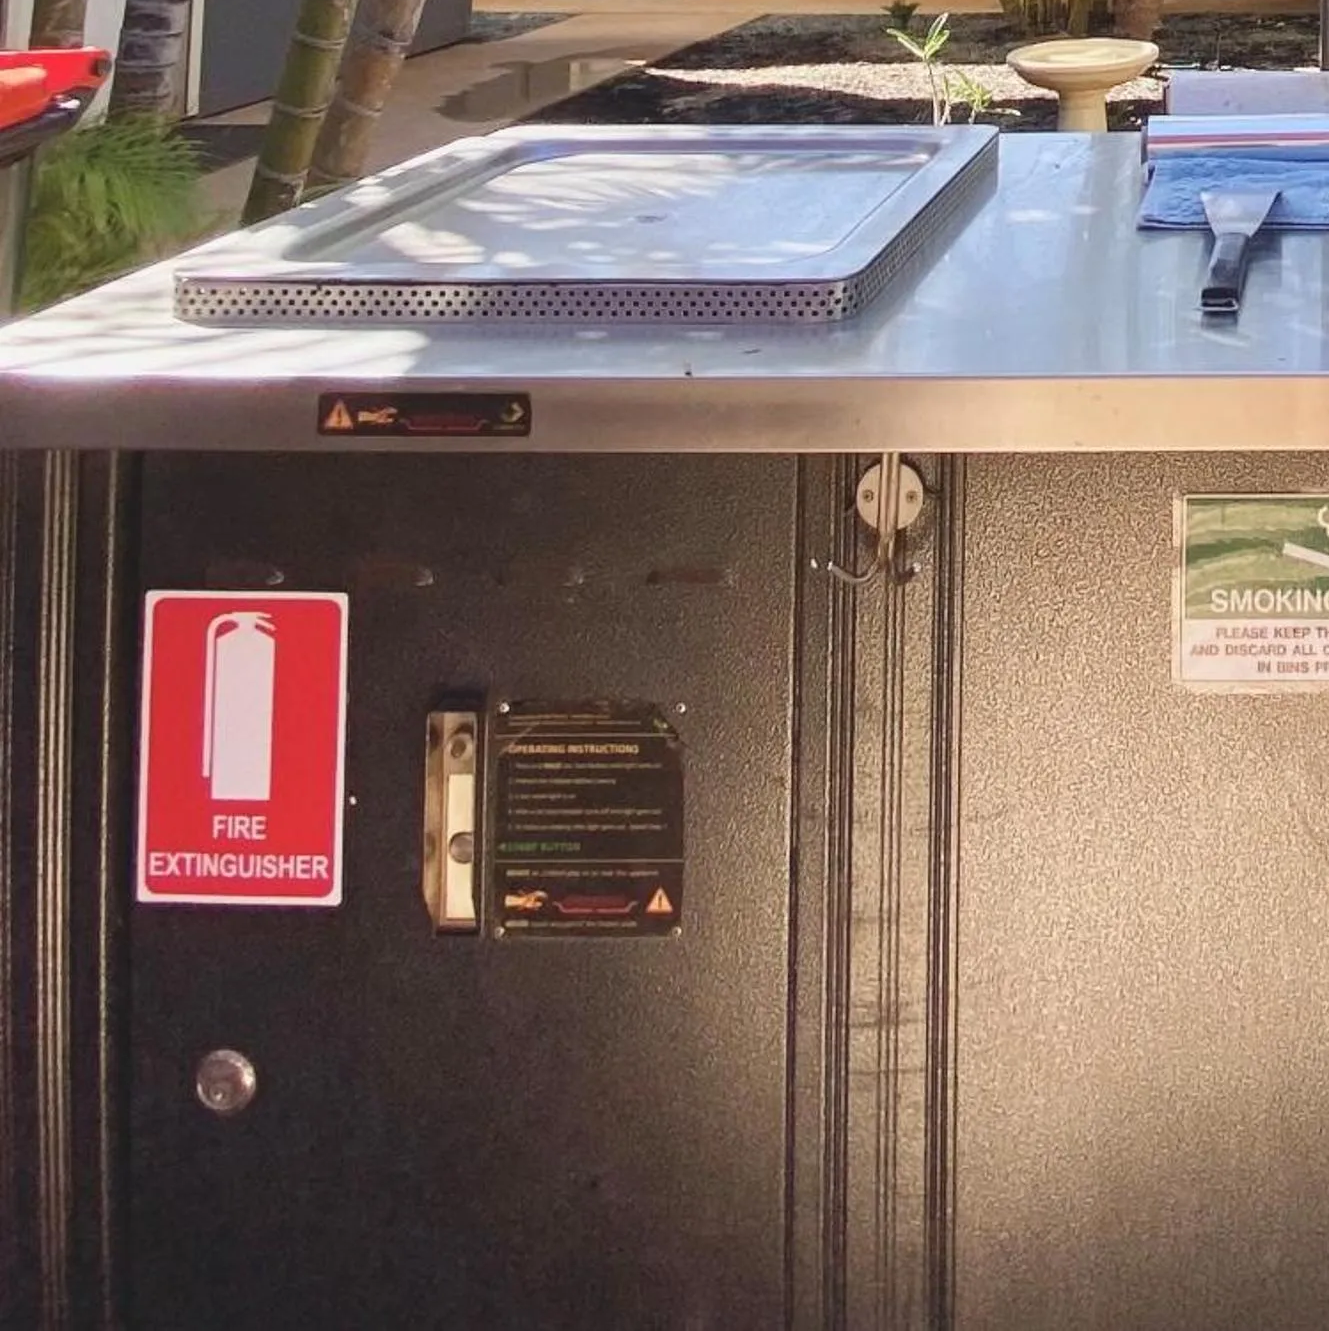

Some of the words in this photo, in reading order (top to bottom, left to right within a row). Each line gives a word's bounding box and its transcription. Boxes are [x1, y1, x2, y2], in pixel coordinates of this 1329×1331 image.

[1215, 626, 1269, 640] PLEASE
[1273, 626, 1312, 640] KEEP
[1190, 644, 1220, 657] AND
[1224, 644, 1287, 657] DISCARD
[1292, 644, 1318, 657] ALL
[1256, 661, 1271, 674] IN
[1276, 661, 1310, 674] BINS
[507, 743, 565, 755] OPERATING
[567, 743, 640, 754] INSTRUCTIONS
[211, 814, 267, 840] FIRE
[149, 851, 330, 879] EXTINGUISHER
